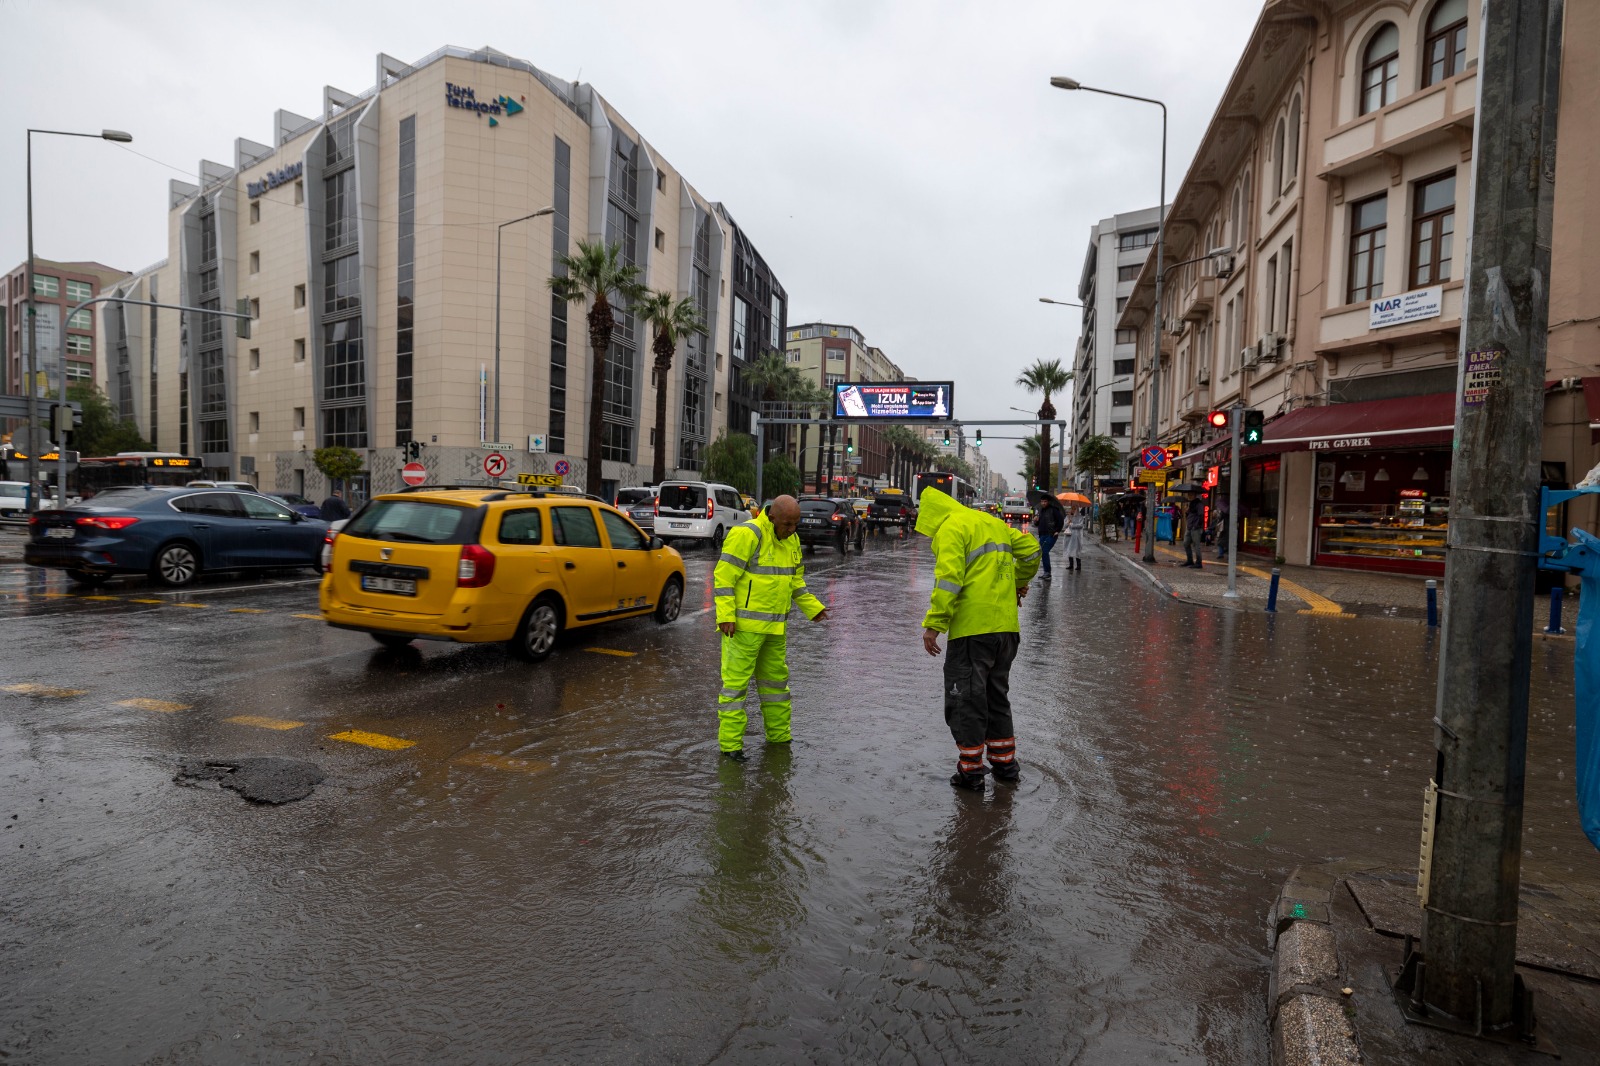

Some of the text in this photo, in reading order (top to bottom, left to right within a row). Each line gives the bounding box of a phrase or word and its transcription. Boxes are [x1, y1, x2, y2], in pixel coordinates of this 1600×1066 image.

[445, 94, 501, 115] Telekom
[1374, 298, 1402, 314] NAR
[1309, 438, 1371, 449] İPEK GEVREK
